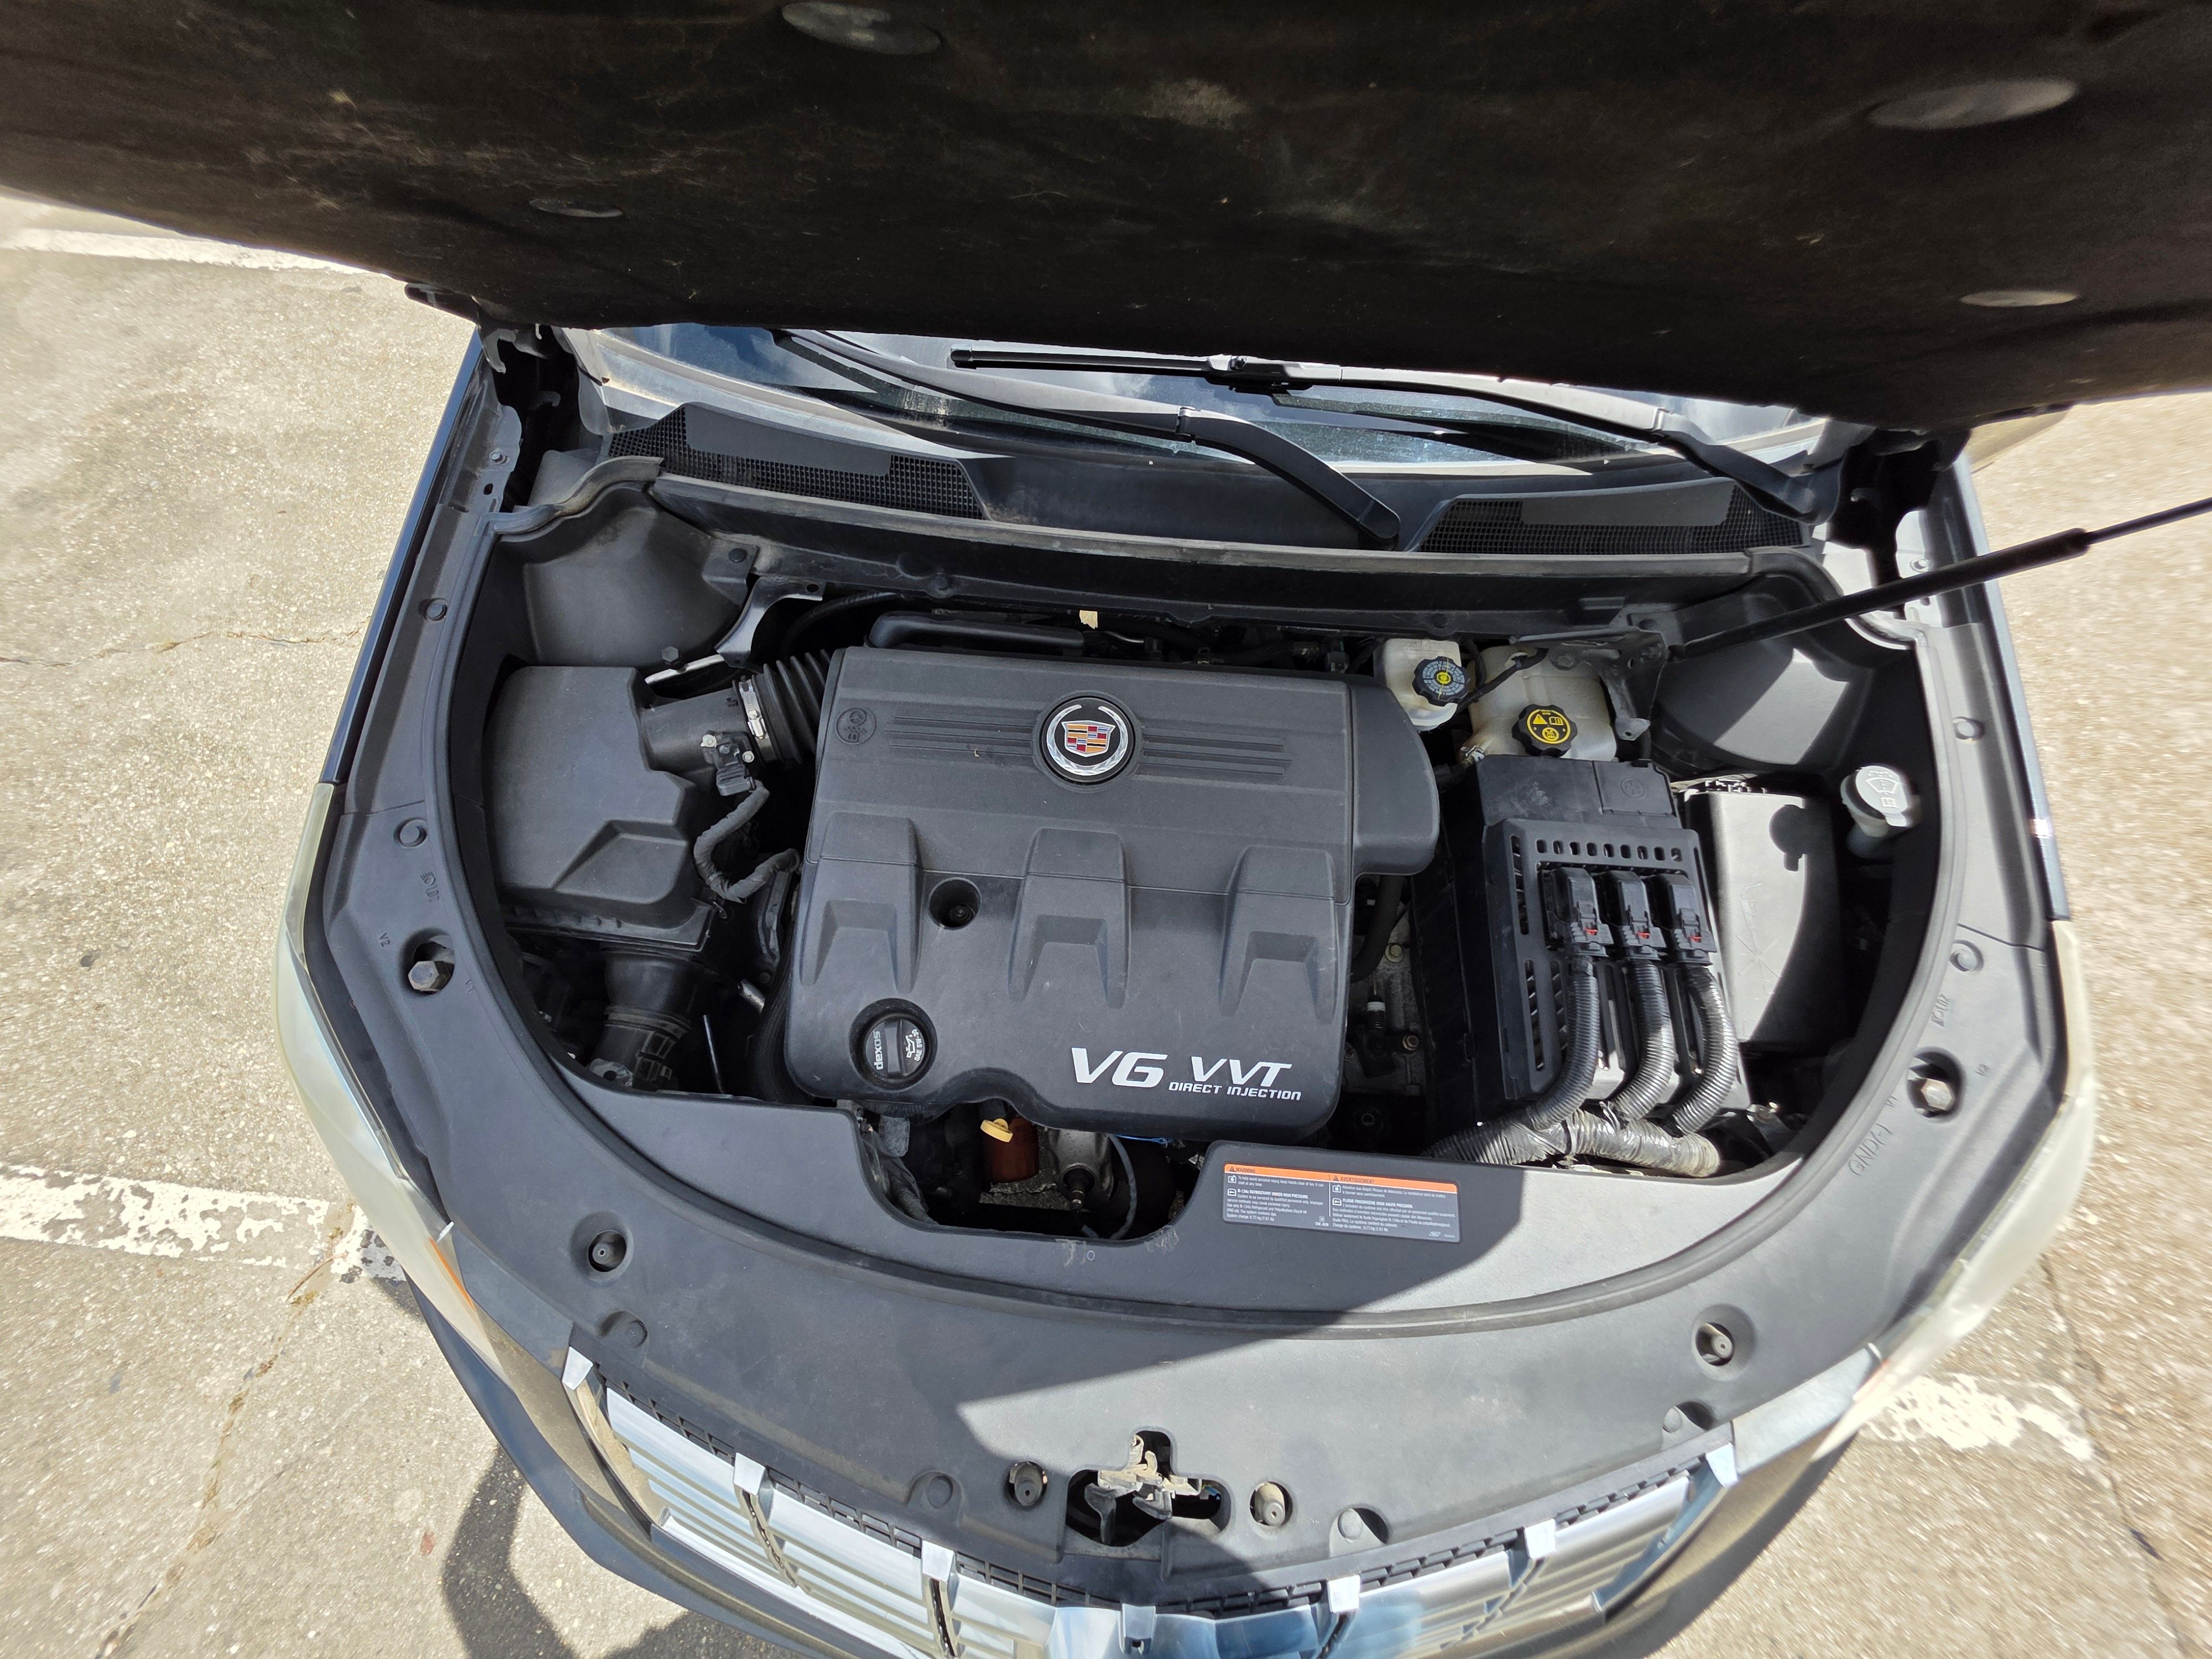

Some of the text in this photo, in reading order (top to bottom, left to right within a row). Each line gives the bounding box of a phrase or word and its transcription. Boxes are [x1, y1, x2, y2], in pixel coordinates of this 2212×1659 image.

[872, 1030, 884, 1070] dexos
[1071, 1047, 1292, 1088] V6 VVT
[1168, 1082, 1301, 1100] DIRECT INJECTION
